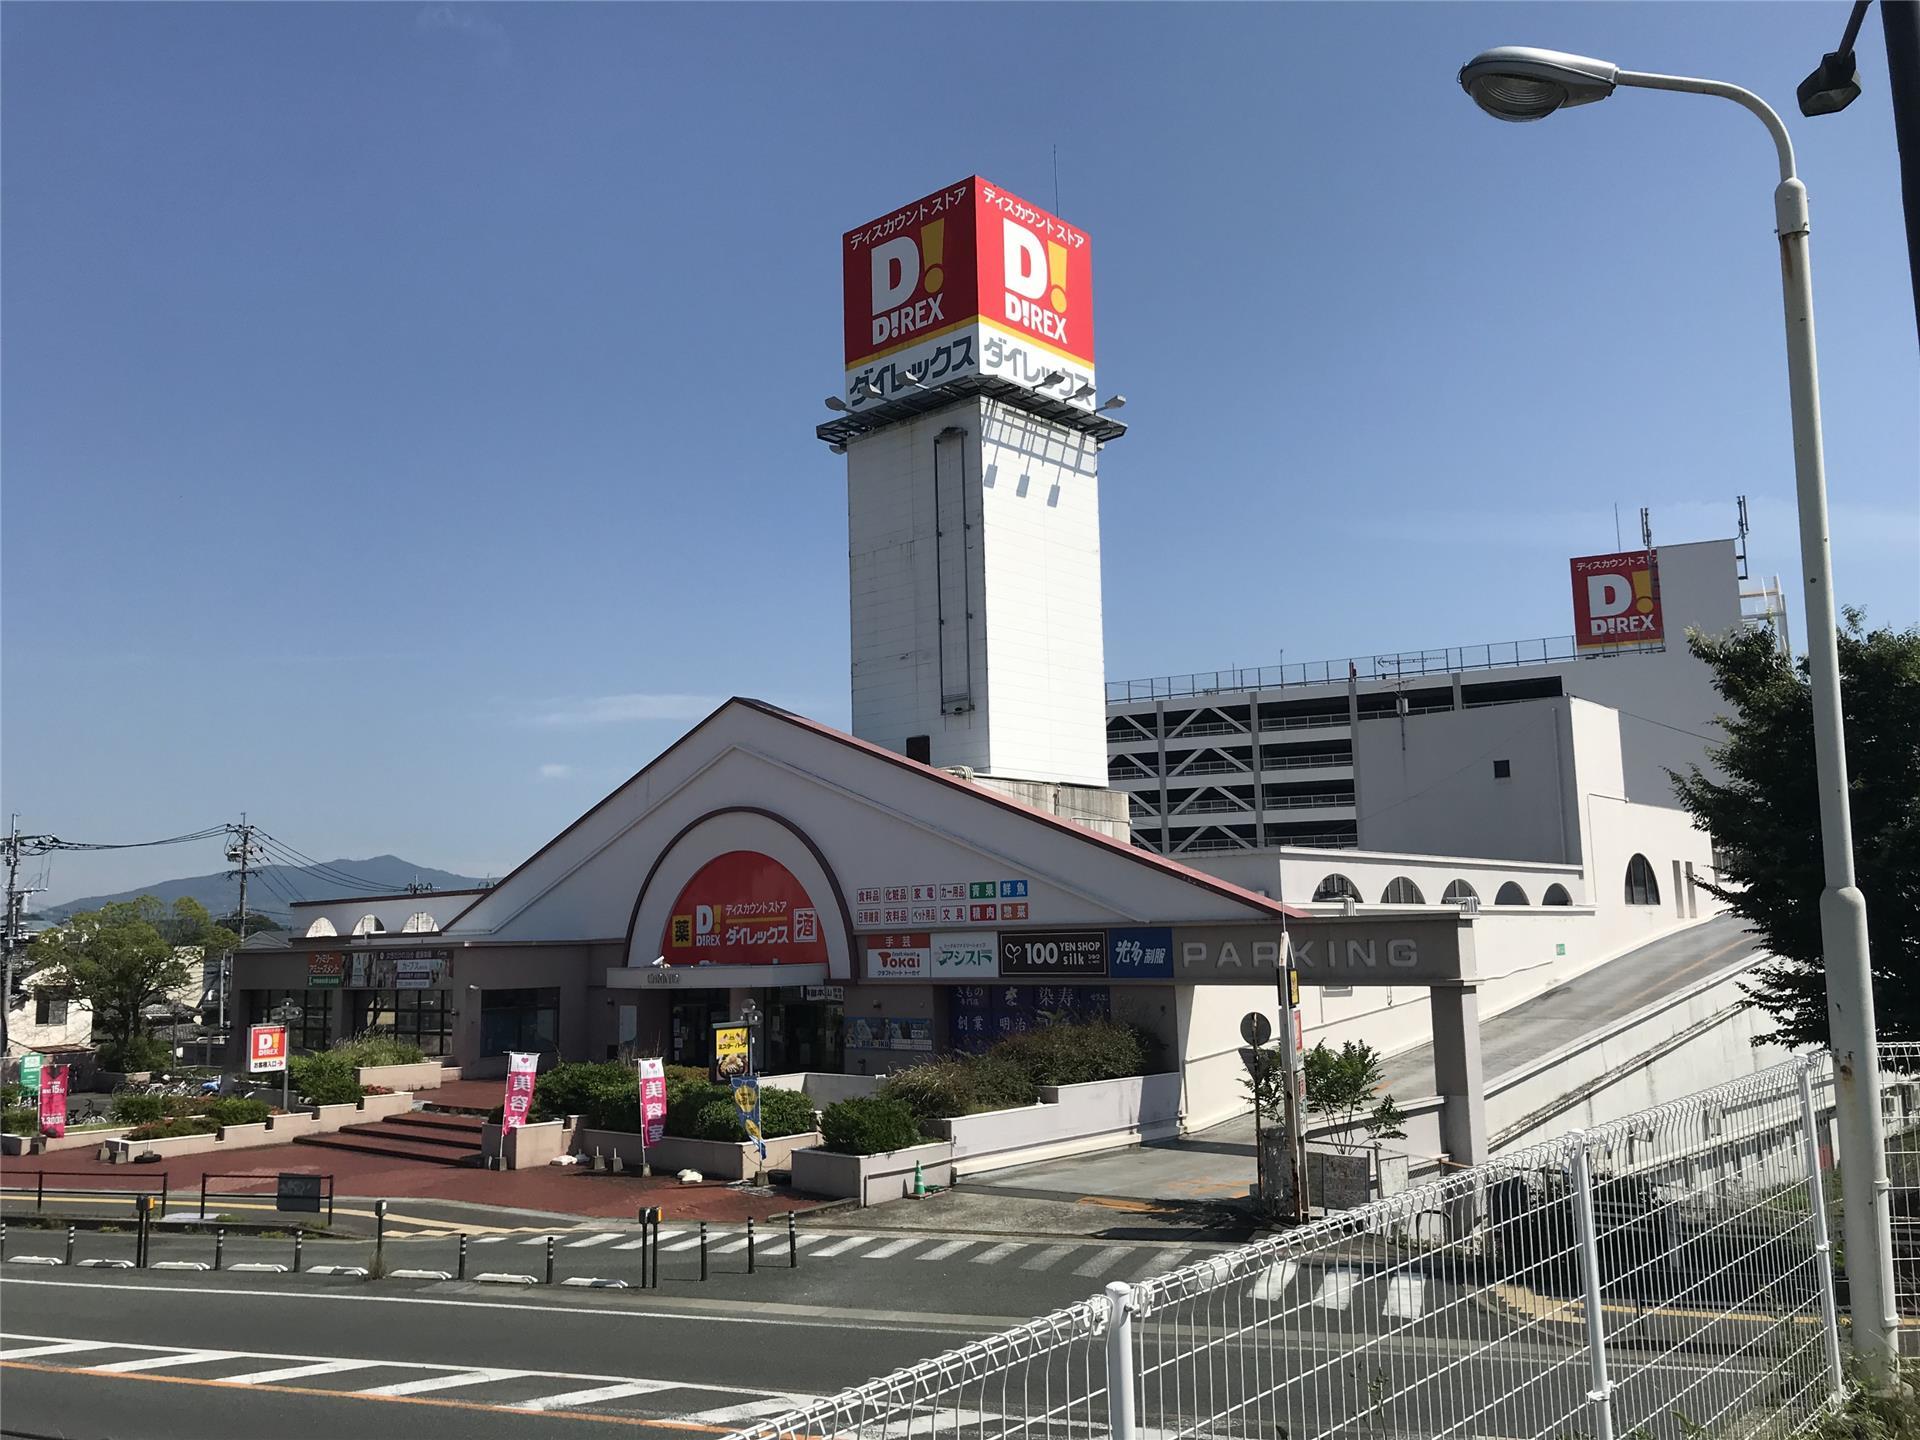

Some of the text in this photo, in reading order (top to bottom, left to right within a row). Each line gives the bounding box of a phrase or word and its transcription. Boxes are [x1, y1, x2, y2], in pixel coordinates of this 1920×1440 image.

[858, 882, 1026, 902] 食料品 化粧品 家電 カー用品 青果 鮮魚
[885, 909, 907, 922] 衣料品
[914, 908, 936, 921] ペット用品
[943, 908, 964, 920] 文具
[675, 919, 690, 942] 薬
[797, 912, 814, 938] 酒
[726, 926, 788, 945] ダイレックス
[885, 935, 911, 948] 手芸
[878, 951, 920, 968] Tokai
[939, 950, 992, 966] アシスト
[1025, 941, 1100, 965] 100 YEN SHOP
[1063, 953, 1085, 965] silk
[1182, 938, 1418, 968] PARKING
[645, 1081, 664, 1142] 美容室
